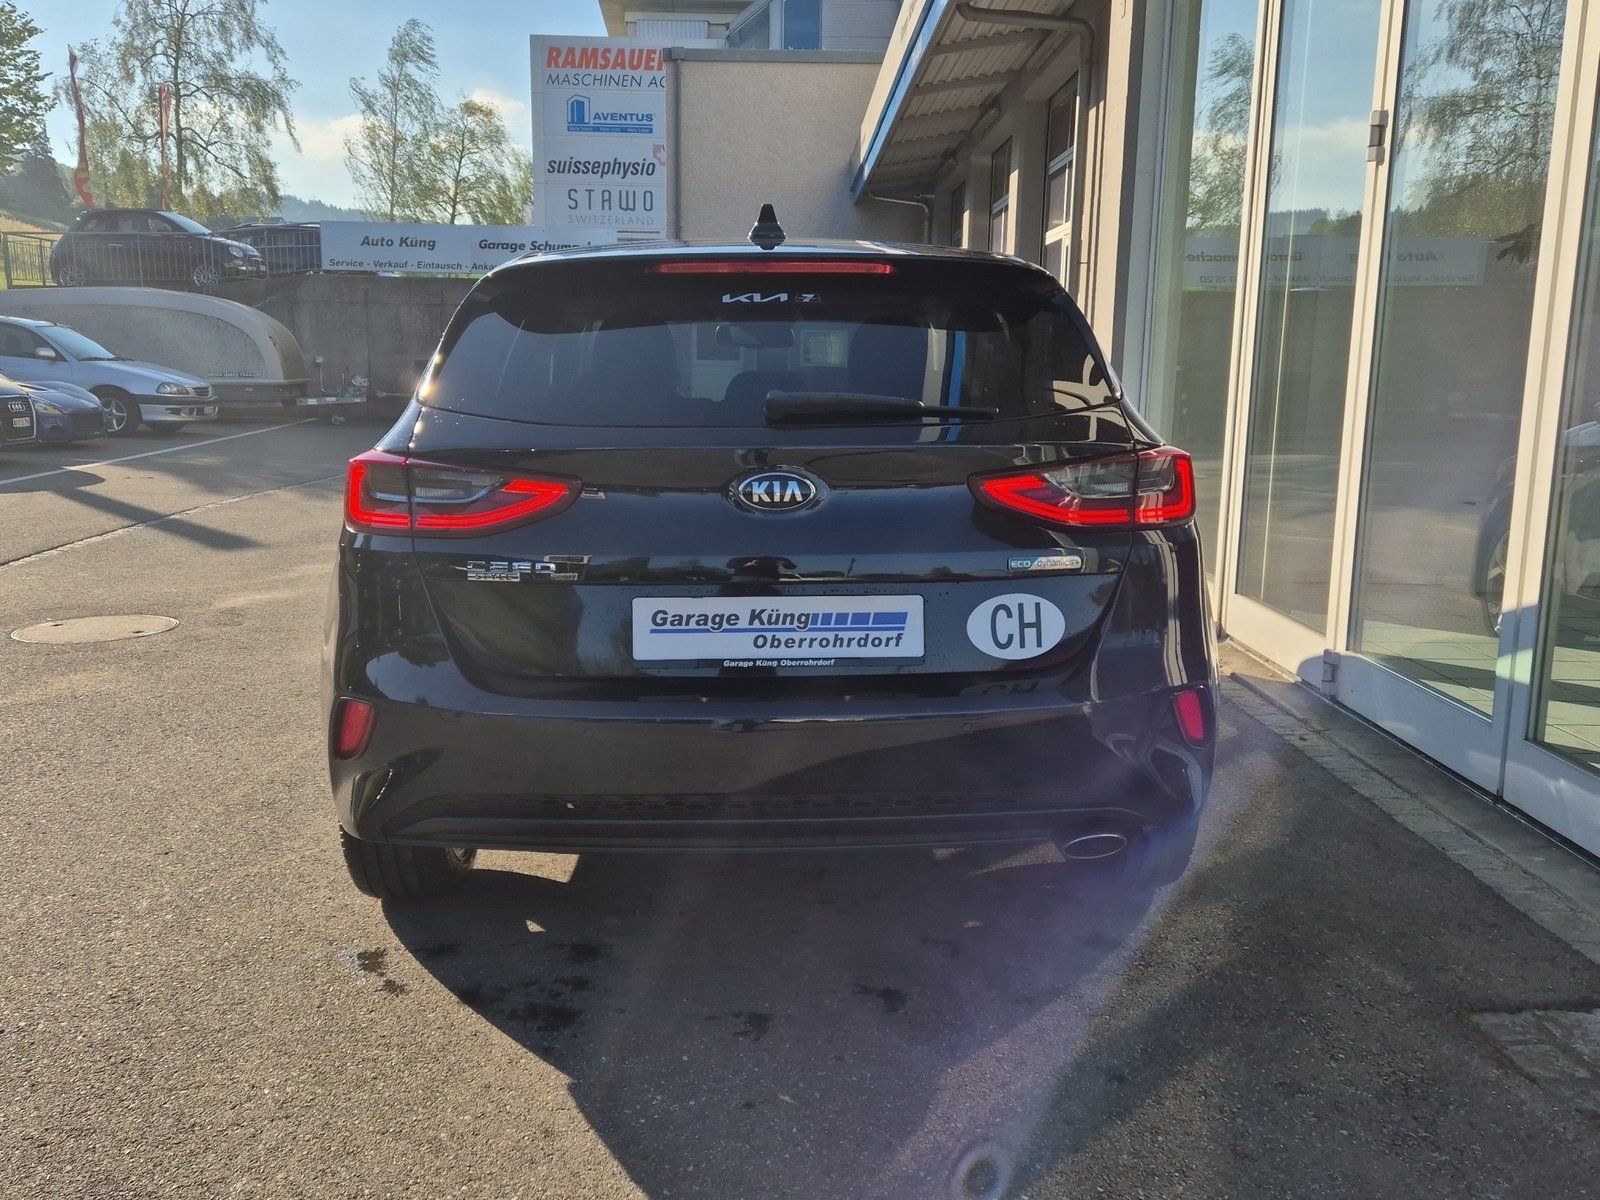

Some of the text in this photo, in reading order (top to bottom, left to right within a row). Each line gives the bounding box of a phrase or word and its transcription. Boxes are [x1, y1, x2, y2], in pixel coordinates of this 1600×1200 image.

[547, 73, 643, 88] MASCHINEN
[593, 112, 654, 122] AVENTUS
[547, 157, 656, 179] suissephysio
[568, 189, 653, 212] STAWO
[568, 214, 655, 226] SWITZERLAND
[361, 236, 437, 250] Auto Küng
[479, 239, 526, 253] Garage
[328, 259, 364, 268] Service
[373, 260, 408, 269] Verkauf
[417, 261, 462, 270] Eintausch
[751, 481, 803, 502] KIA
[1011, 560, 1031, 568] ECO
[651, 609, 811, 631] Garage Küng
[990, 602, 1043, 650] CH
[753, 633, 904, 649] Oberrohrdorf
[723, 658, 835, 668] Garage Küng Oberrohrdorf
